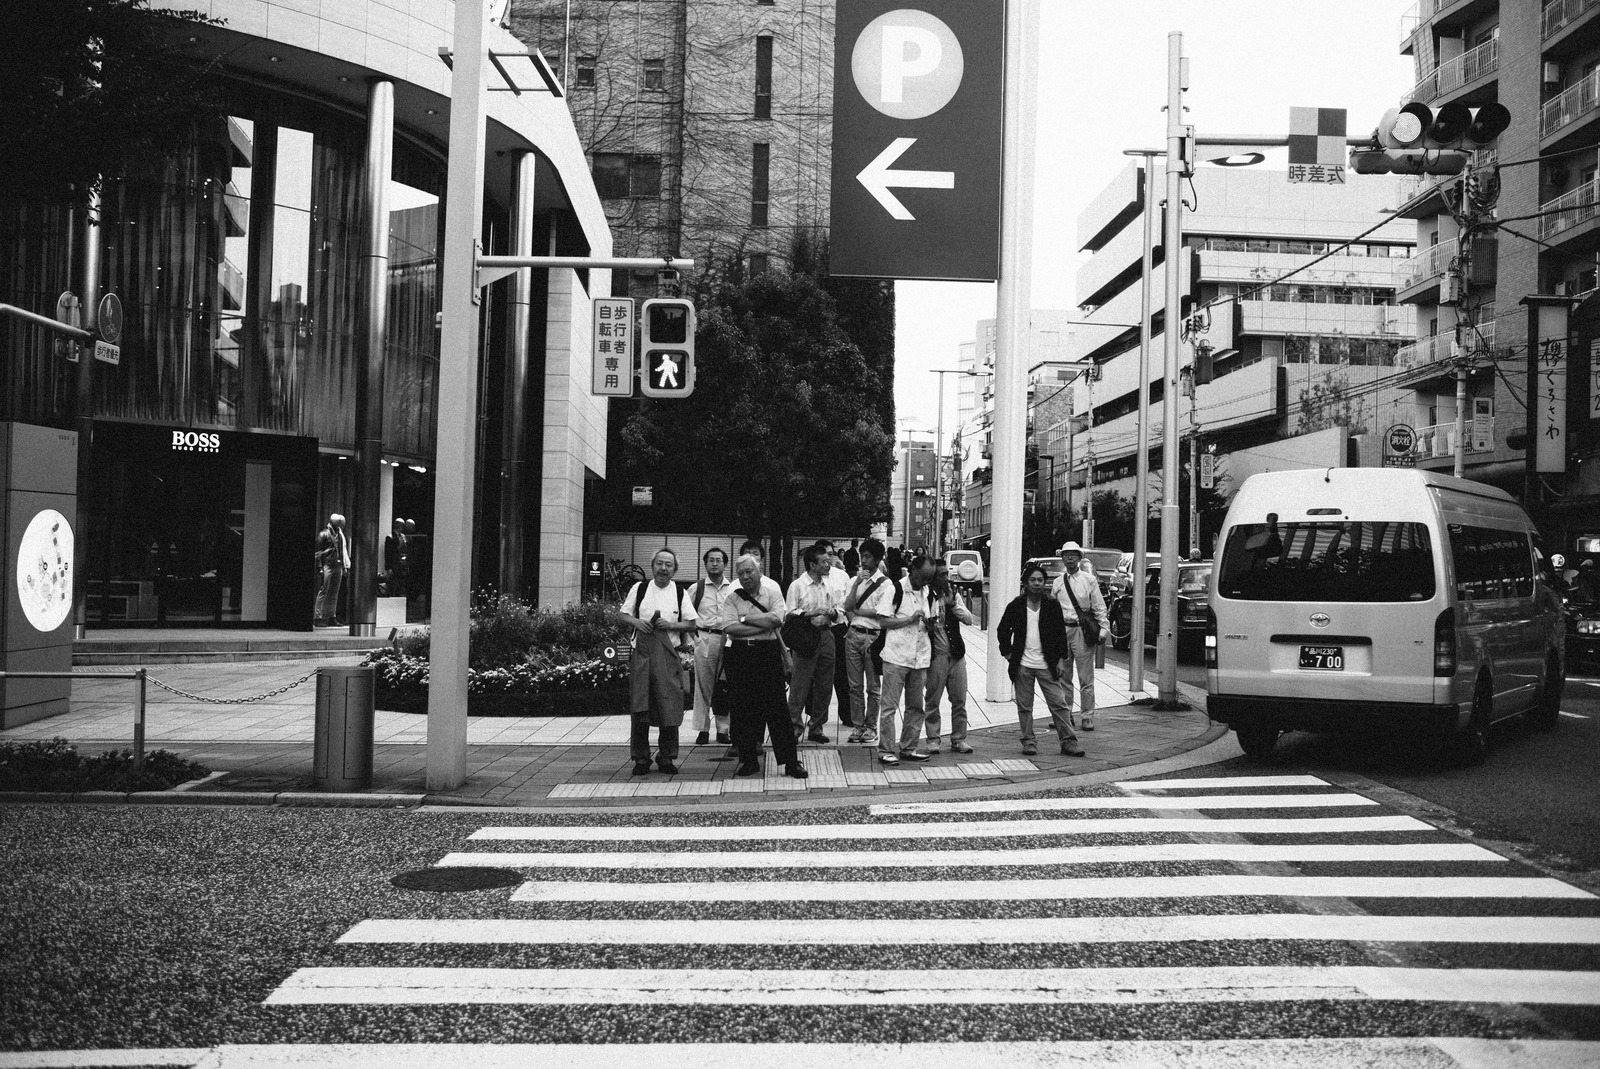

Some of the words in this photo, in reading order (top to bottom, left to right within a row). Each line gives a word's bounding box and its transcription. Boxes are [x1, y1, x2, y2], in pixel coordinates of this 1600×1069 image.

[880, 25, 942, 103] P
[1289, 165, 1344, 183] 時差式
[598, 305, 612, 354] 自転車
[613, 306, 628, 354] 歩行者
[604, 357, 619, 388] 専用
[172, 430, 220, 448] BOSS
